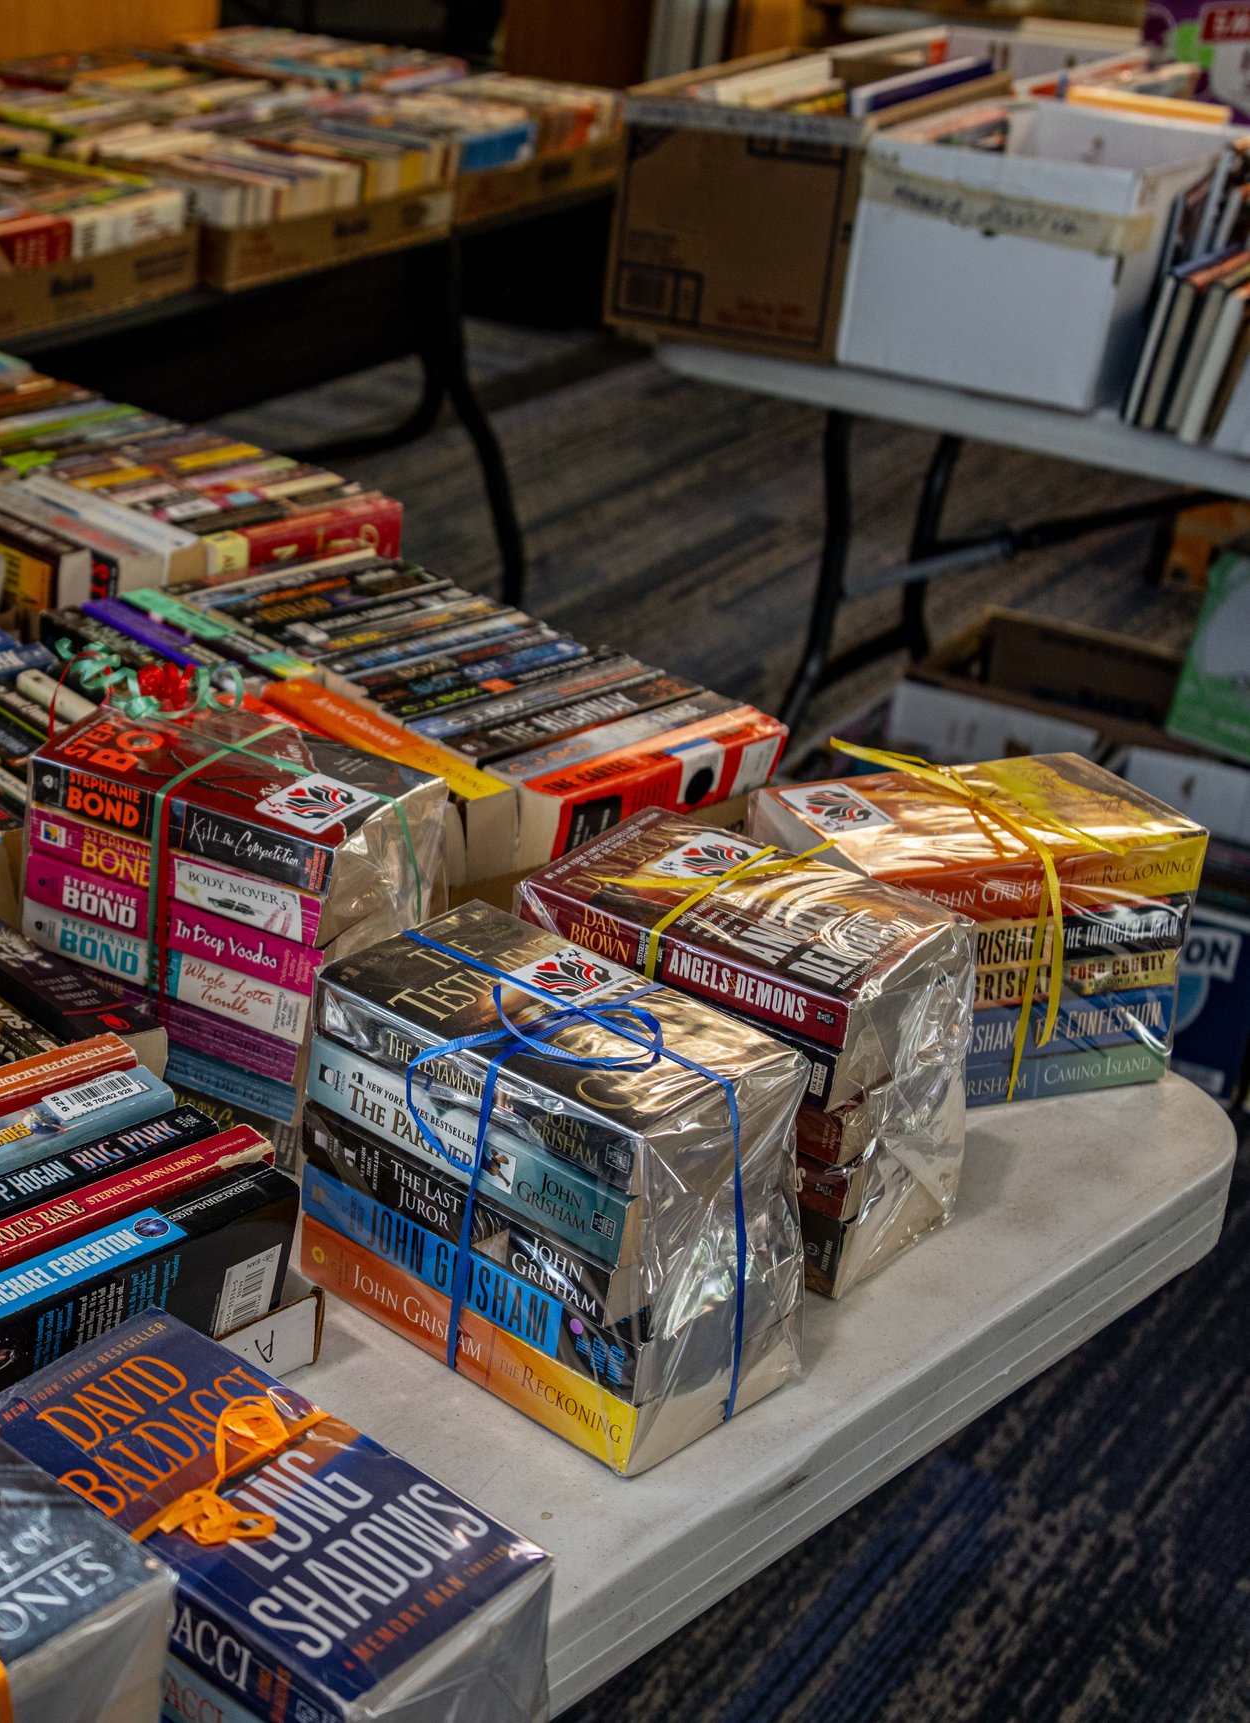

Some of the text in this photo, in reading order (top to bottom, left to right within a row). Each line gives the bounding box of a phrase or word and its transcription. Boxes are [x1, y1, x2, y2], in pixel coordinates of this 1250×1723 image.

[533, 692, 639, 734] HIGHWAY
[66, 785, 140, 828] BOND
[68, 770, 141, 804] STEPHANIE
[234, 830, 301, 866] Competition
[63, 875, 137, 908] STEPHANIE
[188, 870, 290, 911] BODY MOVERS
[1101, 858, 1194, 885] RECKONING
[62, 884, 137, 929] BOND
[582, 906, 622, 938] DAN
[59, 930, 139, 976] BOND
[61, 918, 140, 953] STEPHANIE
[193, 923, 277, 969] Deep Voodoo
[568, 922, 632, 963] BROWN
[183, 960, 274, 1006] Whole Lotta
[668, 948, 807, 1023] ANGELS DEMONS
[1112, 953, 1167, 975] COUNTY
[201, 983, 251, 1016] Trouble
[1066, 1001, 1163, 1039] CONFESSION
[351, 1071, 405, 1107] #1 NEW YORK
[1044, 1054, 1151, 1084] CAMINO ISLAND
[348, 1084, 387, 1128] THE
[0, 1184, 17, 1203] P.
[19, 1161, 75, 1197] HOGAN
[71, 1141, 122, 1172] BUG
[120, 1120, 182, 1153] PARK
[45, 1198, 86, 1226] BANE
[85, 1179, 133, 1206] STEPHEN
[144, 1153, 205, 1188] DONALDSON
[390, 1160, 461, 1214] THE LAST
[397, 1186, 450, 1232] JUROR
[516, 1181, 586, 1234] GRISHAM
[540, 1172, 583, 1210] JOHN
[55, 1230, 144, 1277] CRICHTON
[366, 1205, 425, 1275] JOHN
[529, 1237, 583, 1282] JOHN
[353, 1264, 399, 1312] JOHN
[510, 1253, 598, 1318] GRISHAM
[2, 1322, 168, 1422] NEW YORK TIMES BESTSELLER
[36, 1355, 188, 1452] DAVID
[521, 1364, 623, 1444] RECKONING
[58, 1366, 270, 1520] BALDACCI
[221, 1450, 374, 1573] LONG
[248, 1482, 489, 1658] SHADOWS
[352, 1574, 467, 1662] MEMORY MAN
